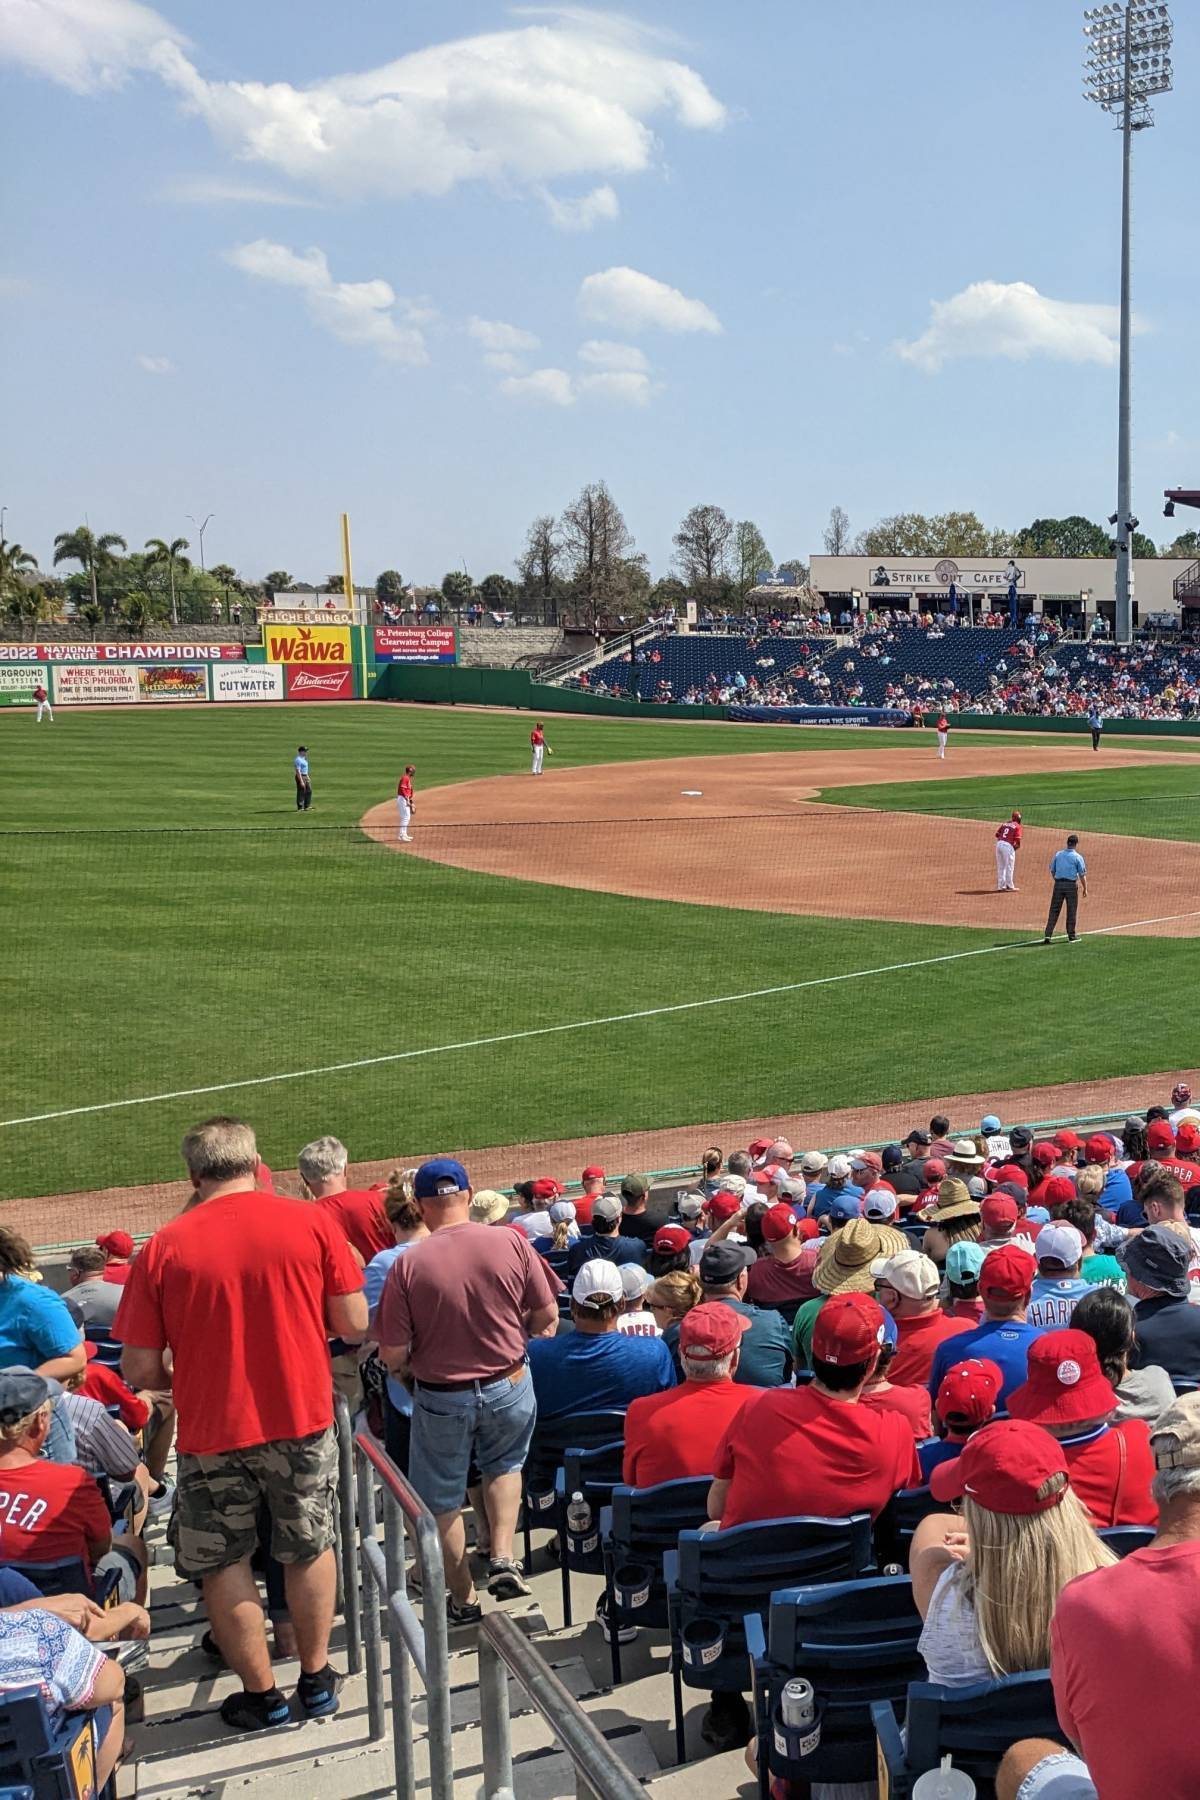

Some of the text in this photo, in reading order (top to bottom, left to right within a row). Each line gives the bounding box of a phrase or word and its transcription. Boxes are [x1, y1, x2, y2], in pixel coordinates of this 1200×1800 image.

[892, 572, 931, 583] STRIKE
[974, 573, 1002, 583] CAFE
[314, 613, 349, 622] BINGO
[387, 629, 426, 639] Petersburg
[426, 629, 453, 639] College
[380, 638, 450, 647] Clearwater Campus
[0, 646, 38, 660] 2022
[44, 646, 101, 654] NATIONAL
[105, 646, 221, 659] CHAMPIONS
[270, 638, 345, 660] Wawa
[0, 669, 43, 678] RGROUND
[66, 669, 95, 677] WHERE
[60, 677, 133, 685] MEETS PHLORIDA
[297, 672, 342, 686] Budweiser
[219, 681, 276, 691] CUTWATER
[1002, 828, 1009, 838] 2
